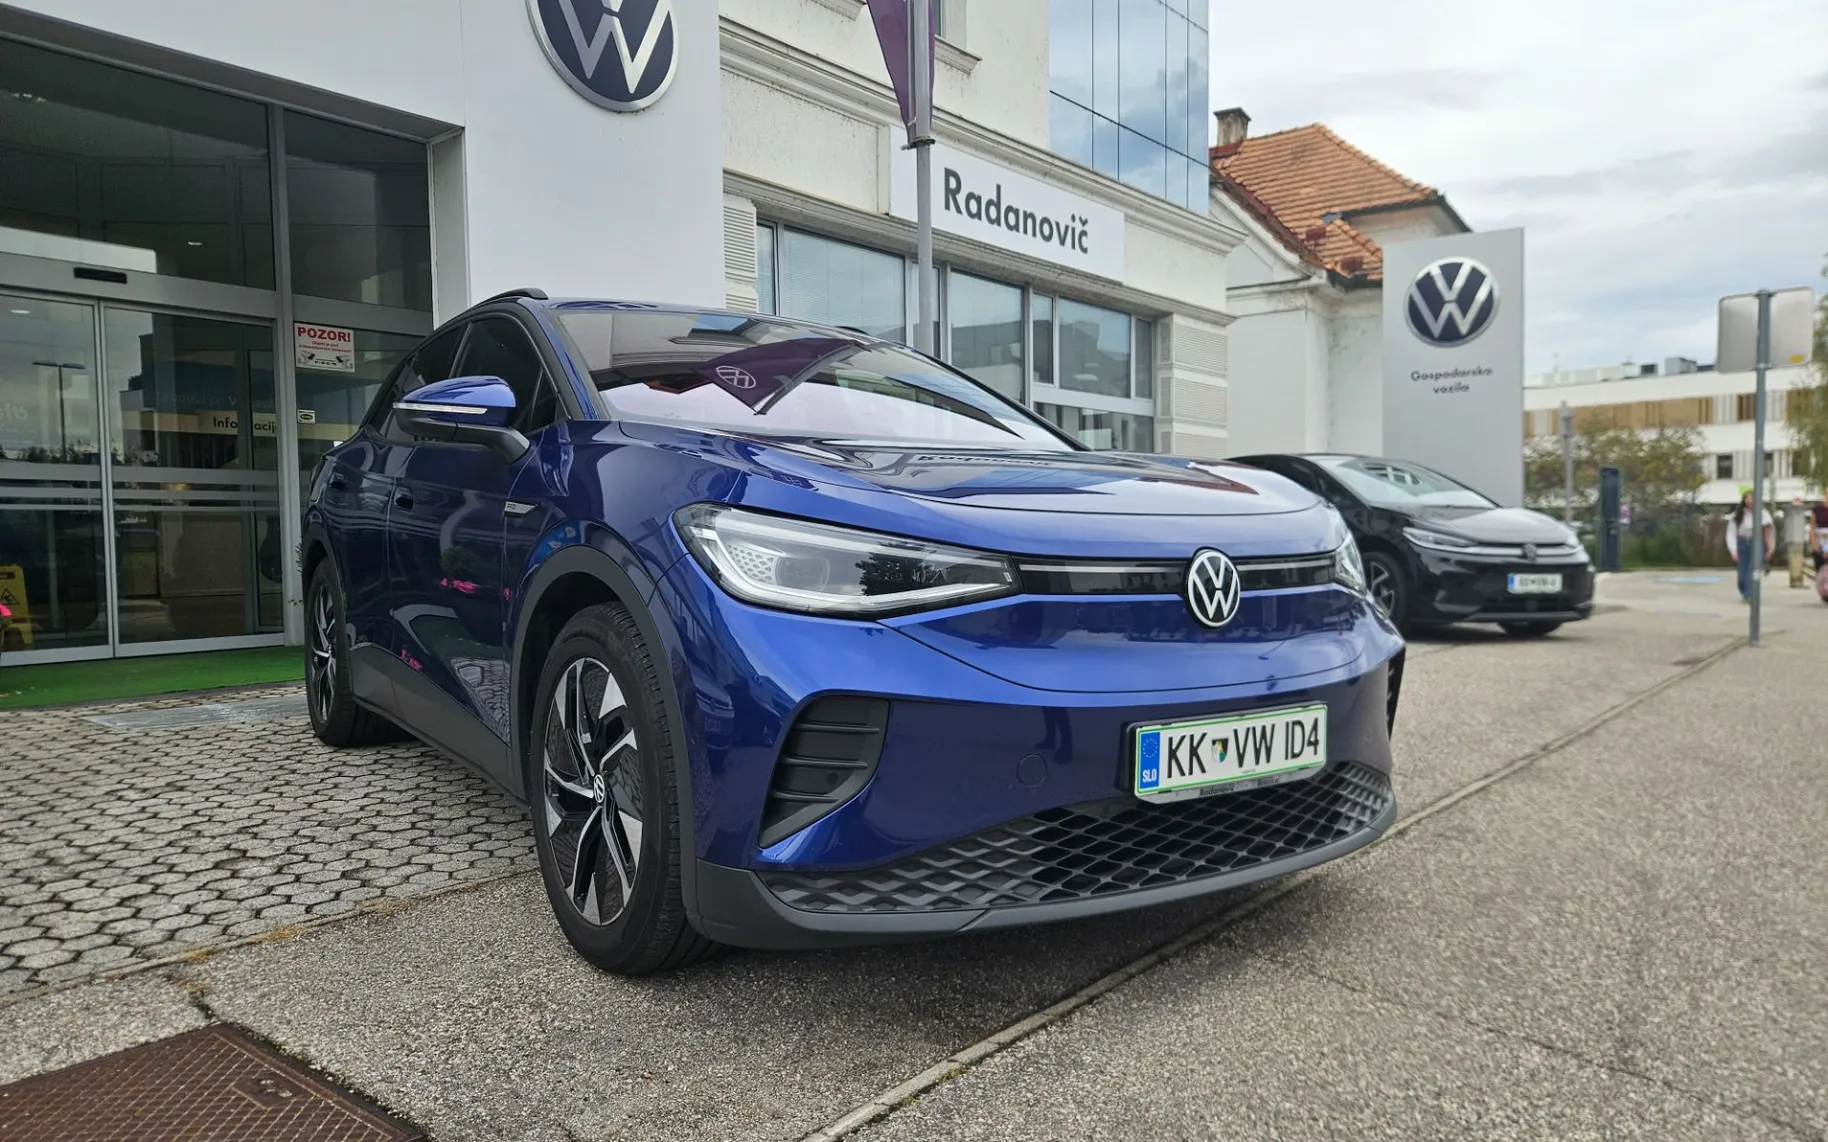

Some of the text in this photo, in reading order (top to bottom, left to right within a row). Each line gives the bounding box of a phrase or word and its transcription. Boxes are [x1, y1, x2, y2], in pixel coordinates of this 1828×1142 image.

[944, 167, 1089, 254] Radanovič
[297, 326, 351, 343] POZOR!
[1167, 717, 1320, 779] KK VW ID4
[1142, 769, 1157, 783] SLO
